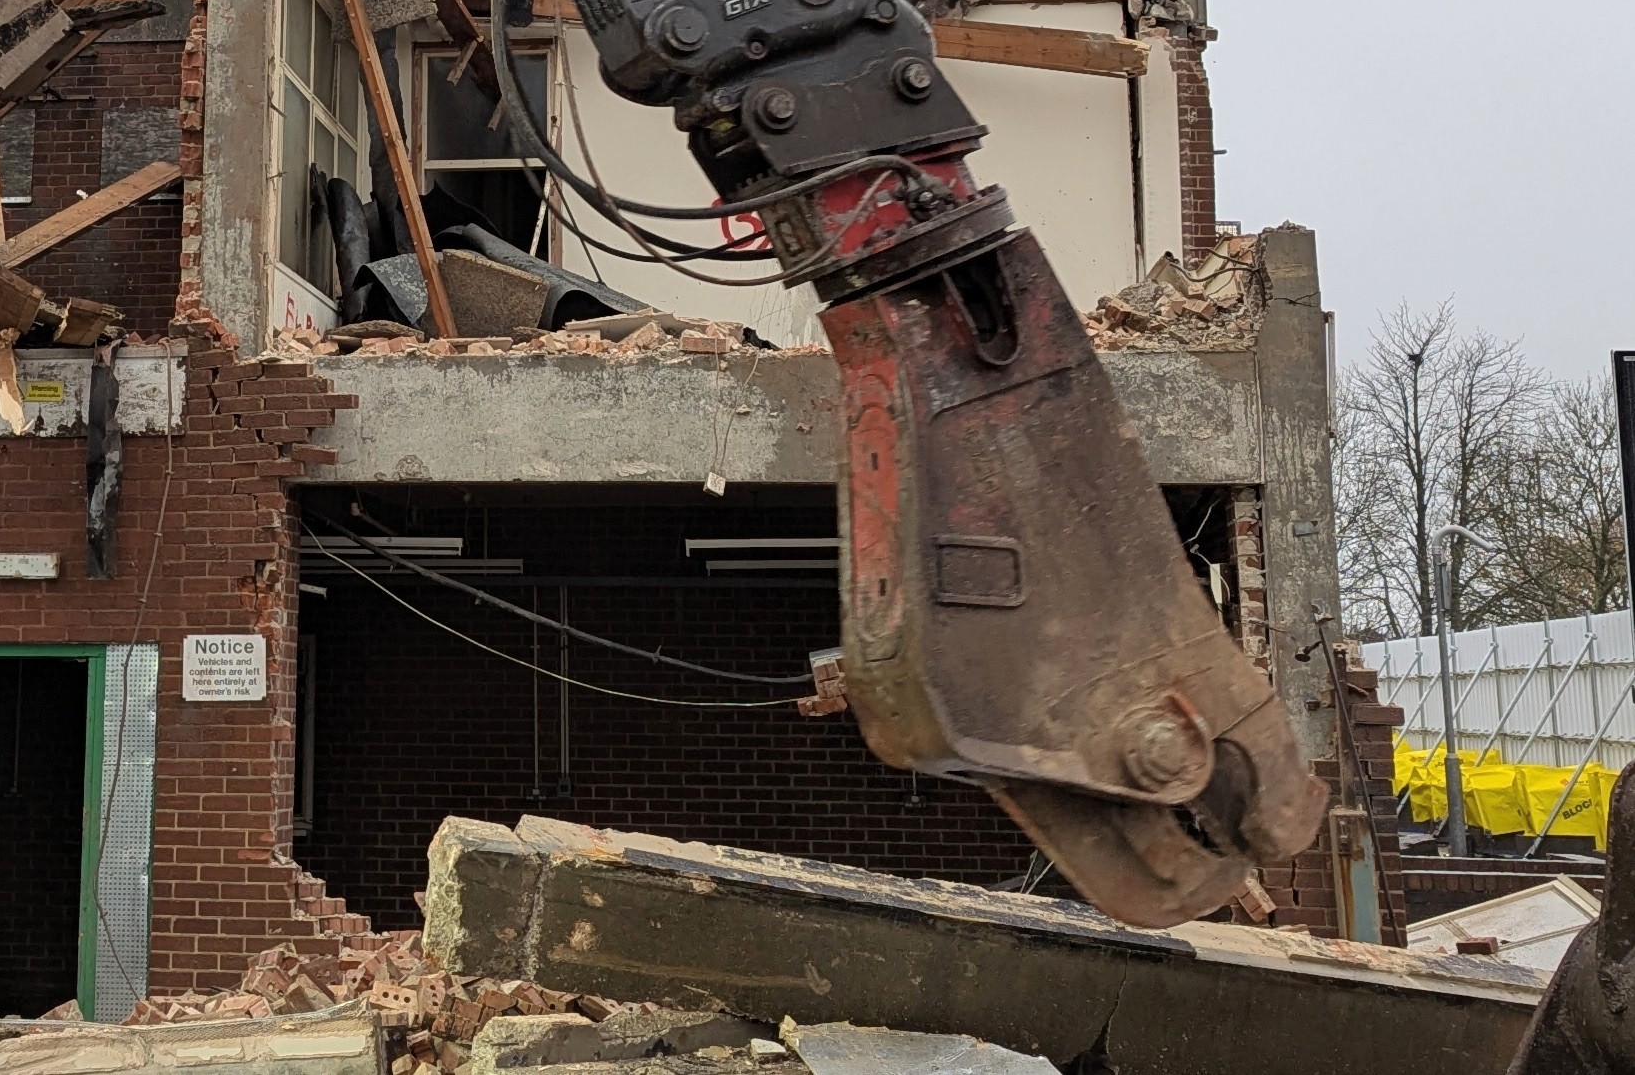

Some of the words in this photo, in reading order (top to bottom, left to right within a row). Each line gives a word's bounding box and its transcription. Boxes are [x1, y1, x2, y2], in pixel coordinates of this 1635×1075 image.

[195, 639, 254, 654] Notice
[189, 668, 226, 676] contents
[214, 677, 246, 687] entirely
[198, 688, 232, 696] owner's
[234, 688, 250, 696] risk
